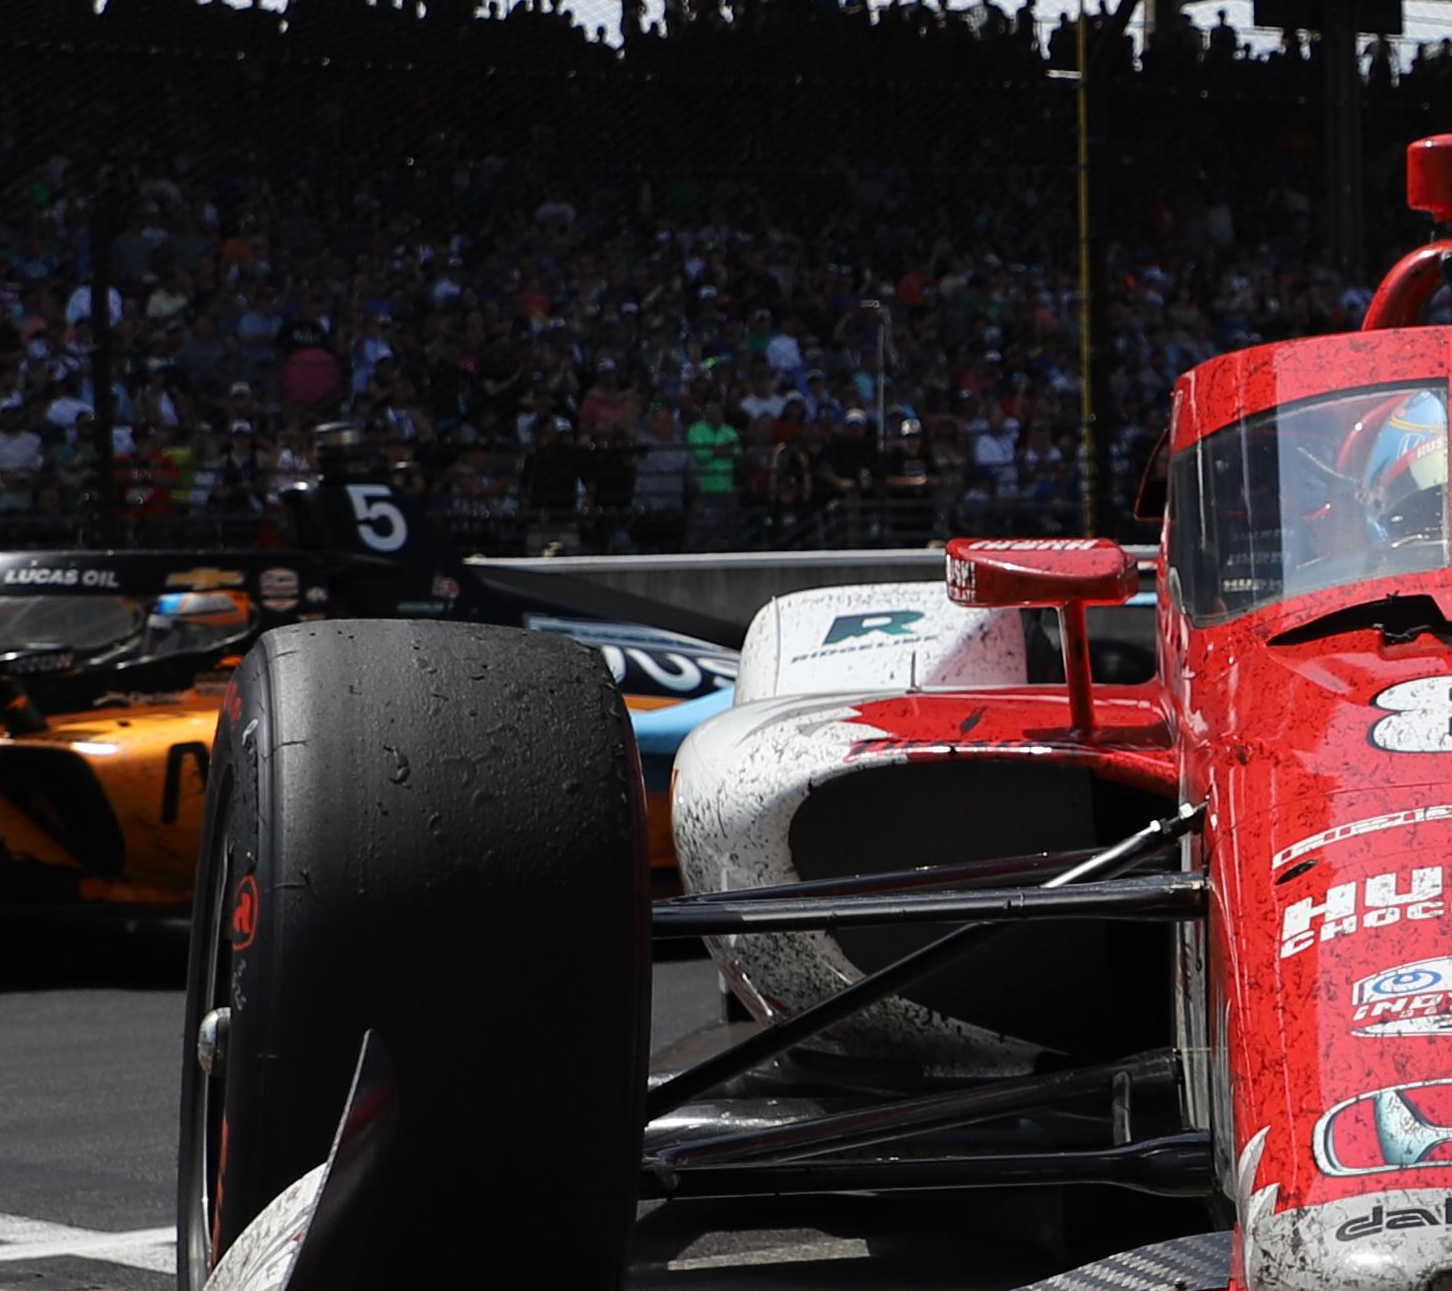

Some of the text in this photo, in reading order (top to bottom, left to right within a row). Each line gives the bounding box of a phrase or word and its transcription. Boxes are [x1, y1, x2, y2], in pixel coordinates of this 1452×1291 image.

[345, 482, 409, 553] 5
[3, 568, 120, 589] LUCAS OIL
